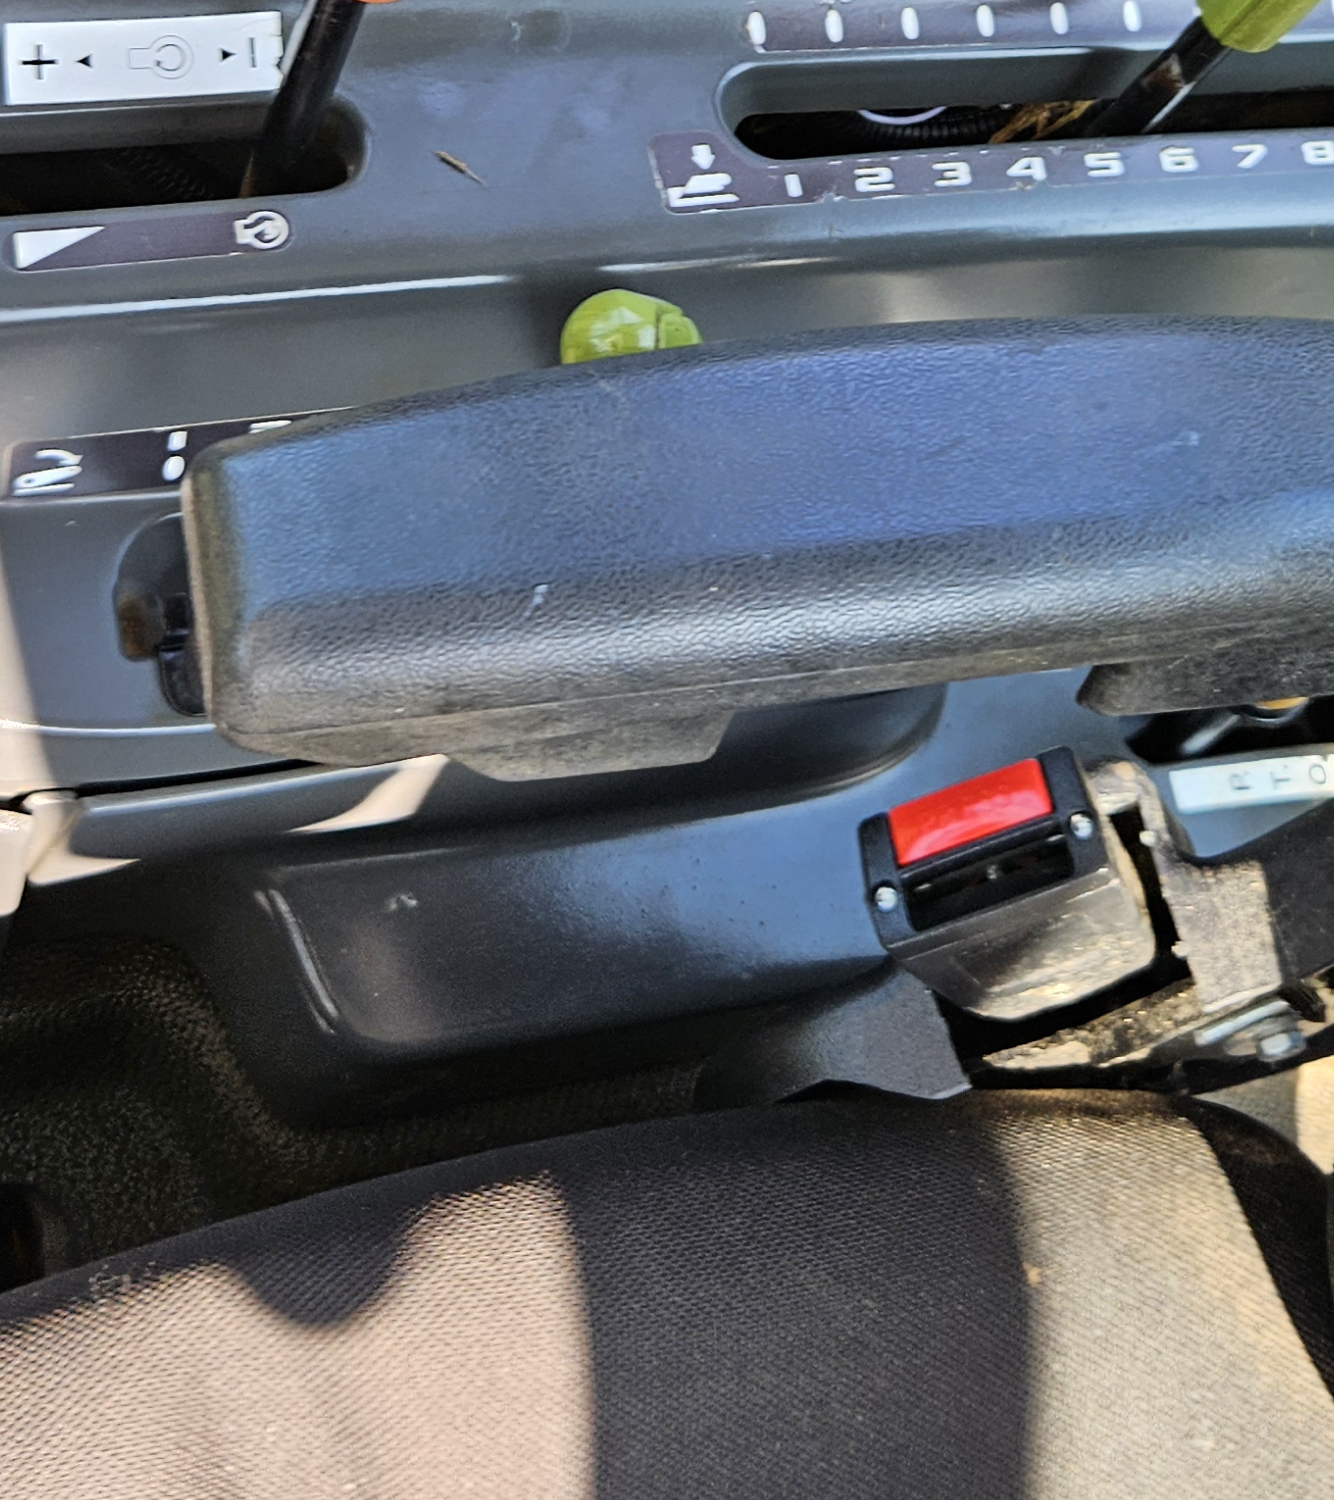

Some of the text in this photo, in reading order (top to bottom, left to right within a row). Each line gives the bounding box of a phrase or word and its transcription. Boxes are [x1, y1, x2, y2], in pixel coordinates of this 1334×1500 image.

[784, 173, 803, 198] 1
[853, 167, 895, 192] 2
[932, 162, 972, 187] 3
[1006, 157, 1047, 181] 4
[1083, 151, 1124, 177] 5
[1159, 147, 1199, 173] 6
[1232, 143, 1267, 169] 7
